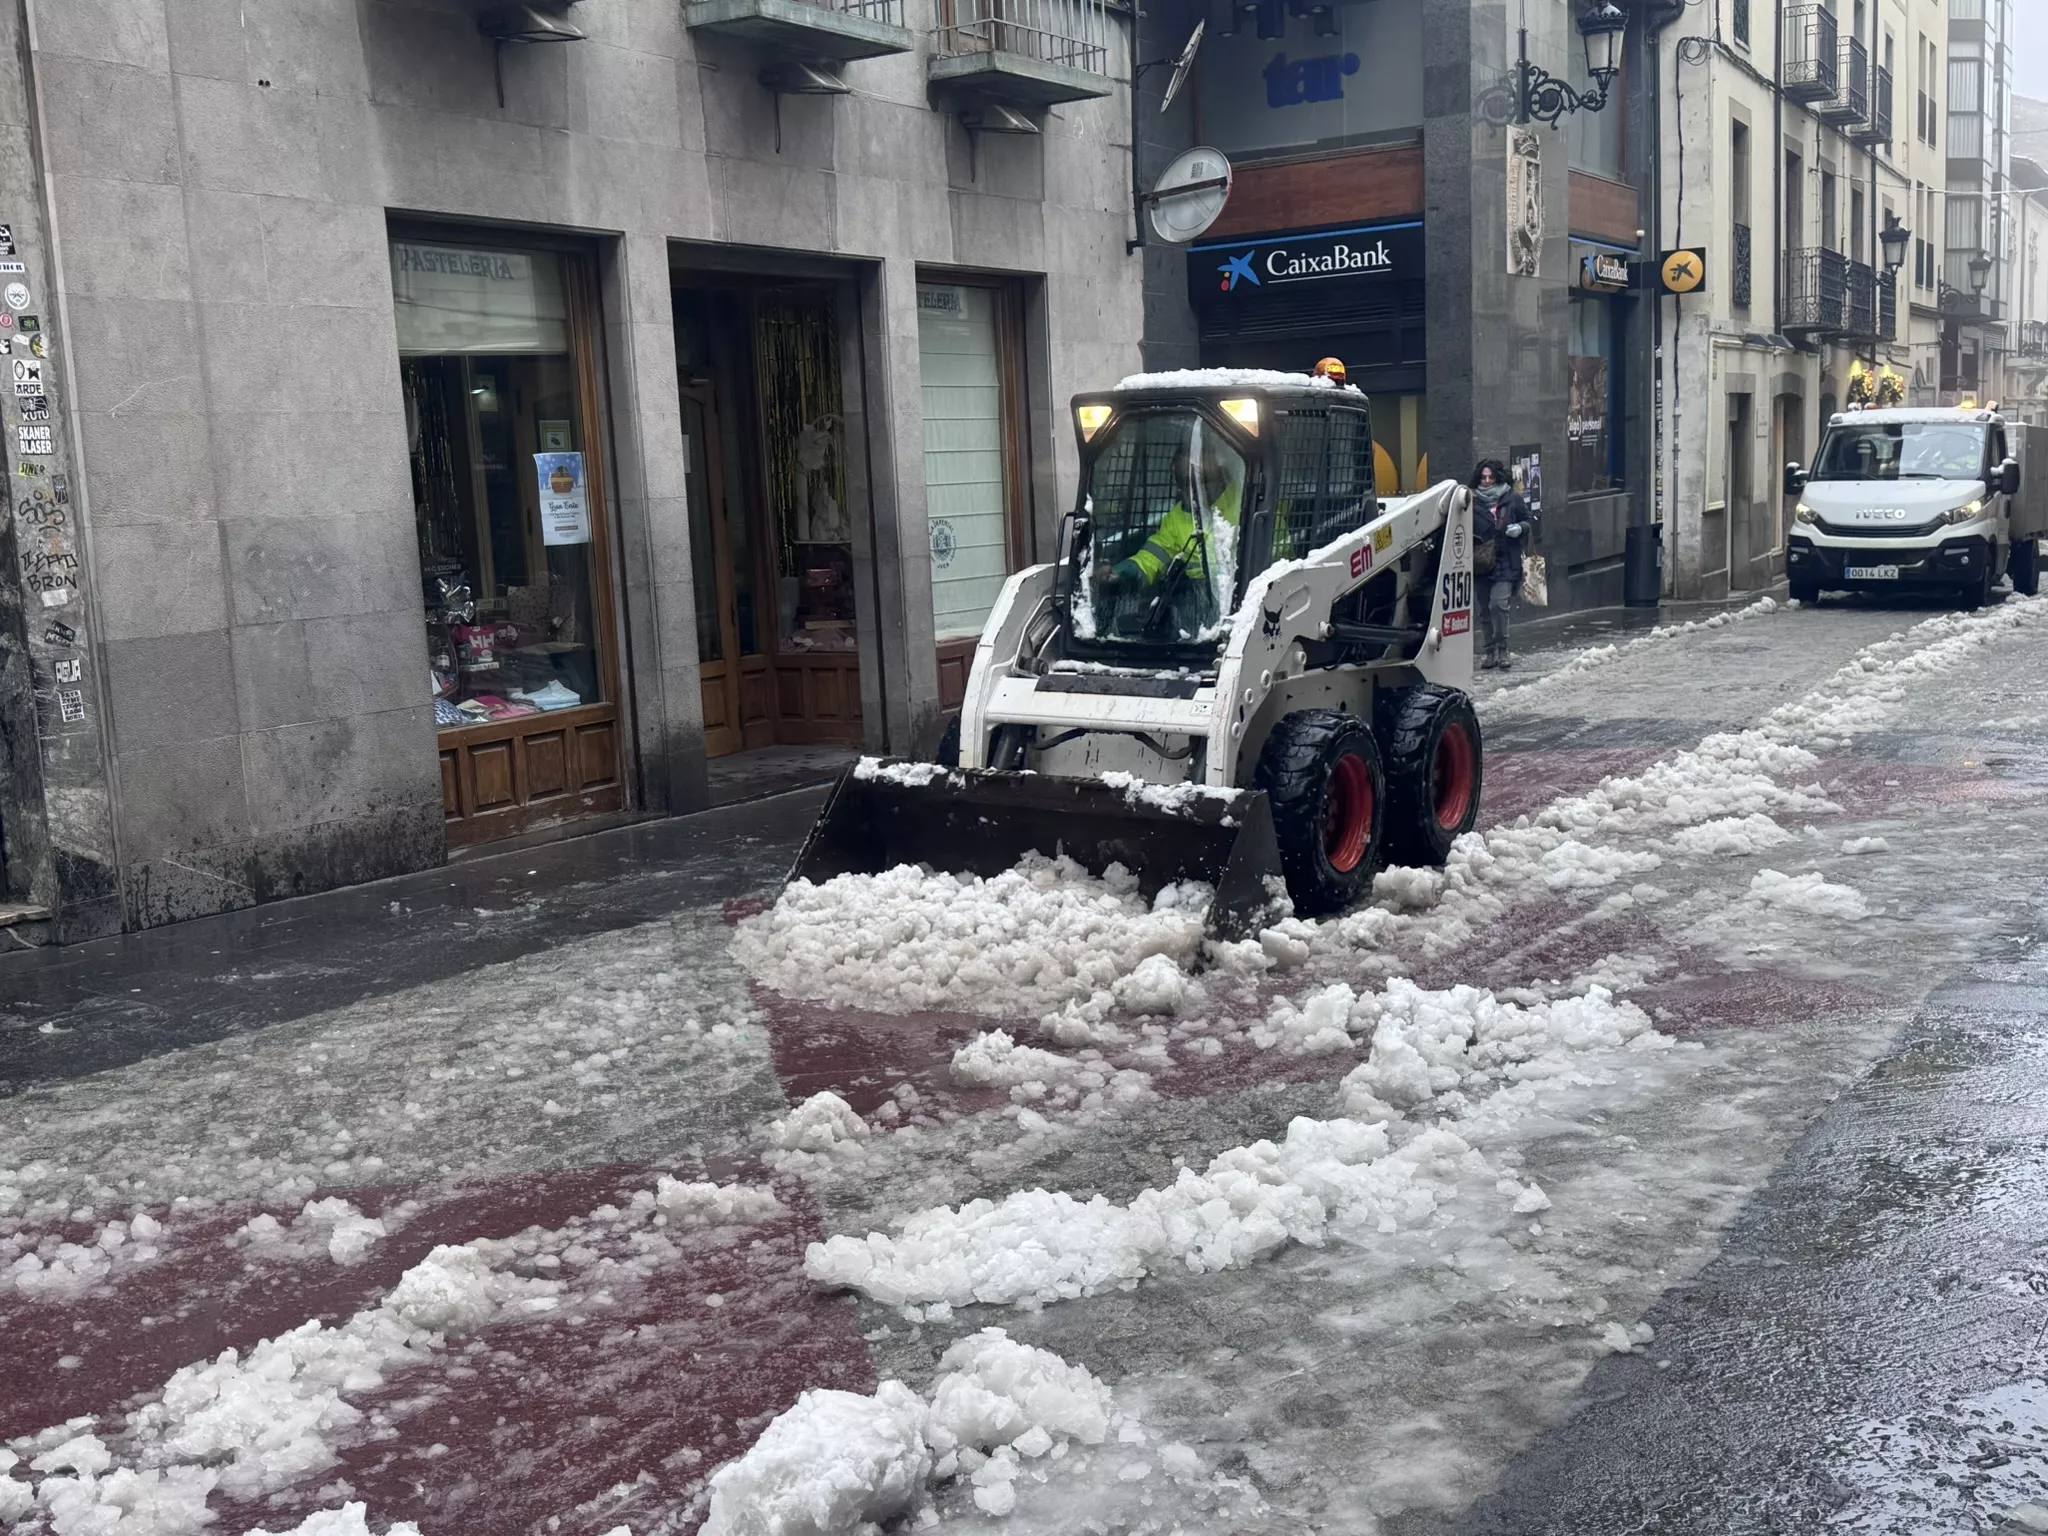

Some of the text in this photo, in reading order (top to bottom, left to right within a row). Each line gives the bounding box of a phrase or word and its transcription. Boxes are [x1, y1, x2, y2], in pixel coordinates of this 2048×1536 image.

[1266, 240, 1392, 276] CaixaBank
[1597, 254, 1629, 282] CaixaBank
[22, 410, 50, 422] KUTU
[18, 426, 51, 440] SKANER
[20, 440, 53, 454] BLASER
[1855, 508, 1906, 520] IVECO
[1350, 544, 1373, 579] EM
[1851, 568, 1896, 578] 0014 LKZ
[1442, 571, 1472, 611] S150
